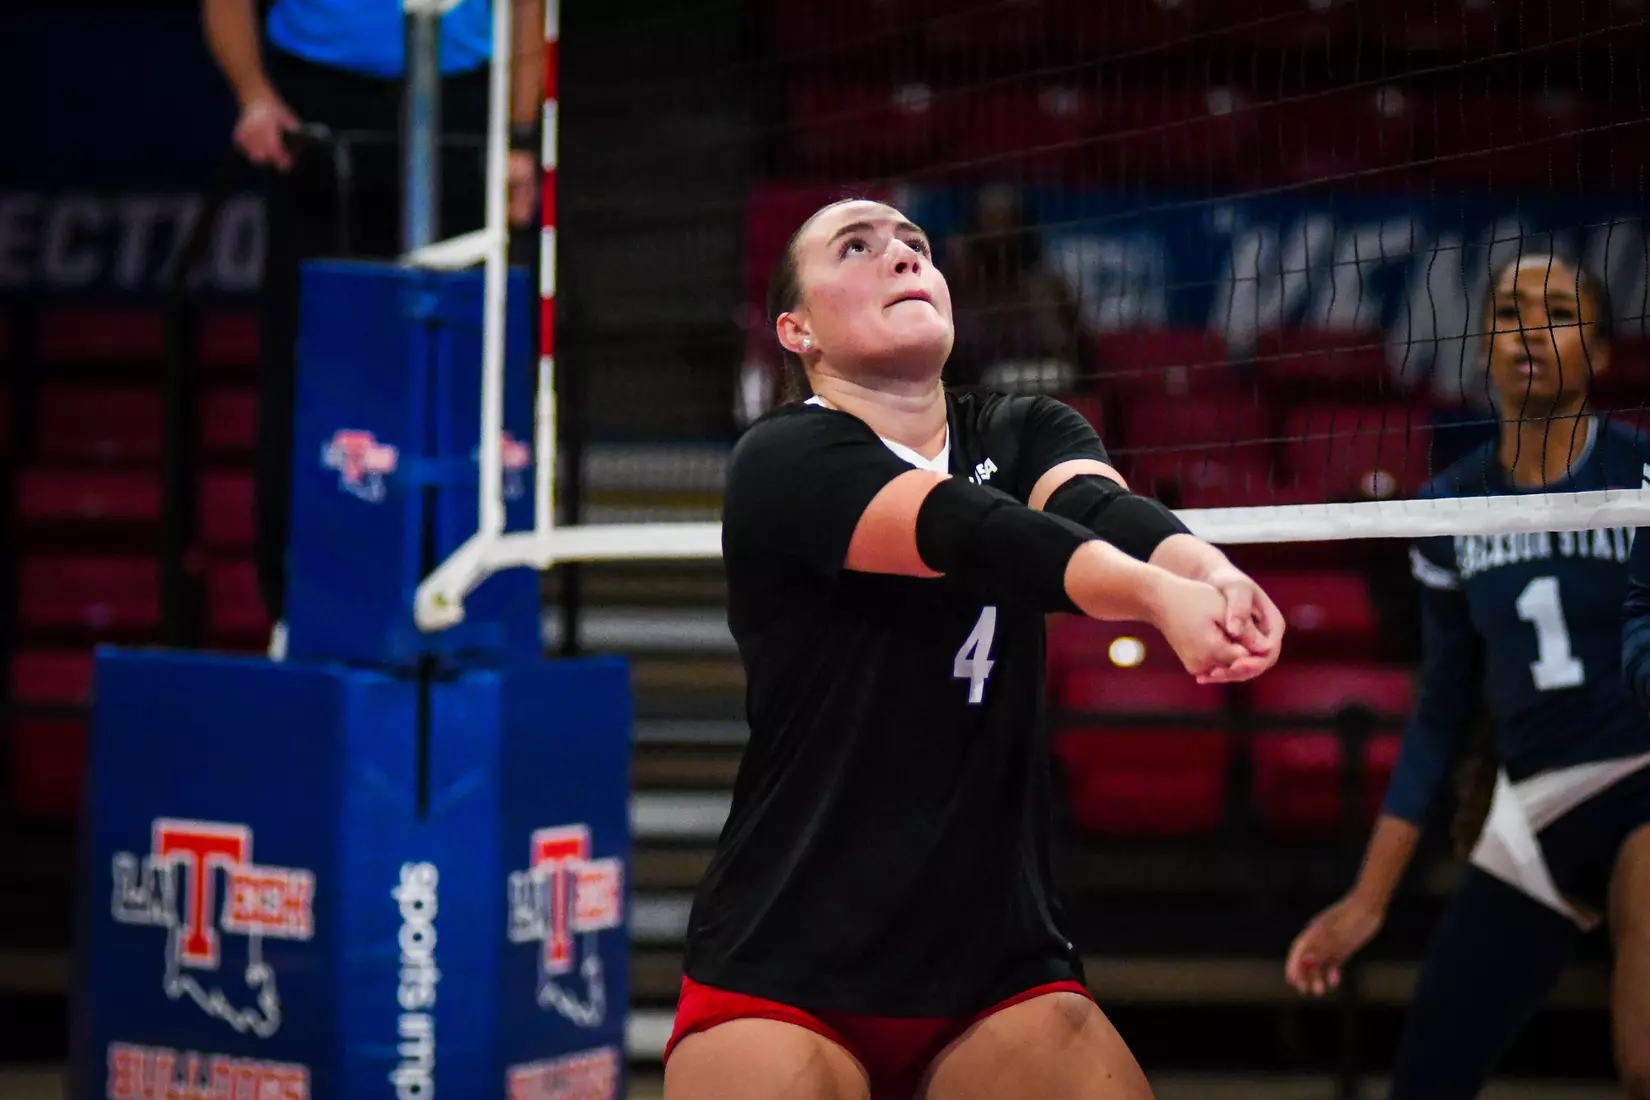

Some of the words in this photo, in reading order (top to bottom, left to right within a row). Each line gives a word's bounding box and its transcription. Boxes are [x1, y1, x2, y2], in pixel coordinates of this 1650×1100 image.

[953, 606, 998, 704] 4
[1516, 576, 1585, 691] 1
[390, 861, 442, 1010] sports
